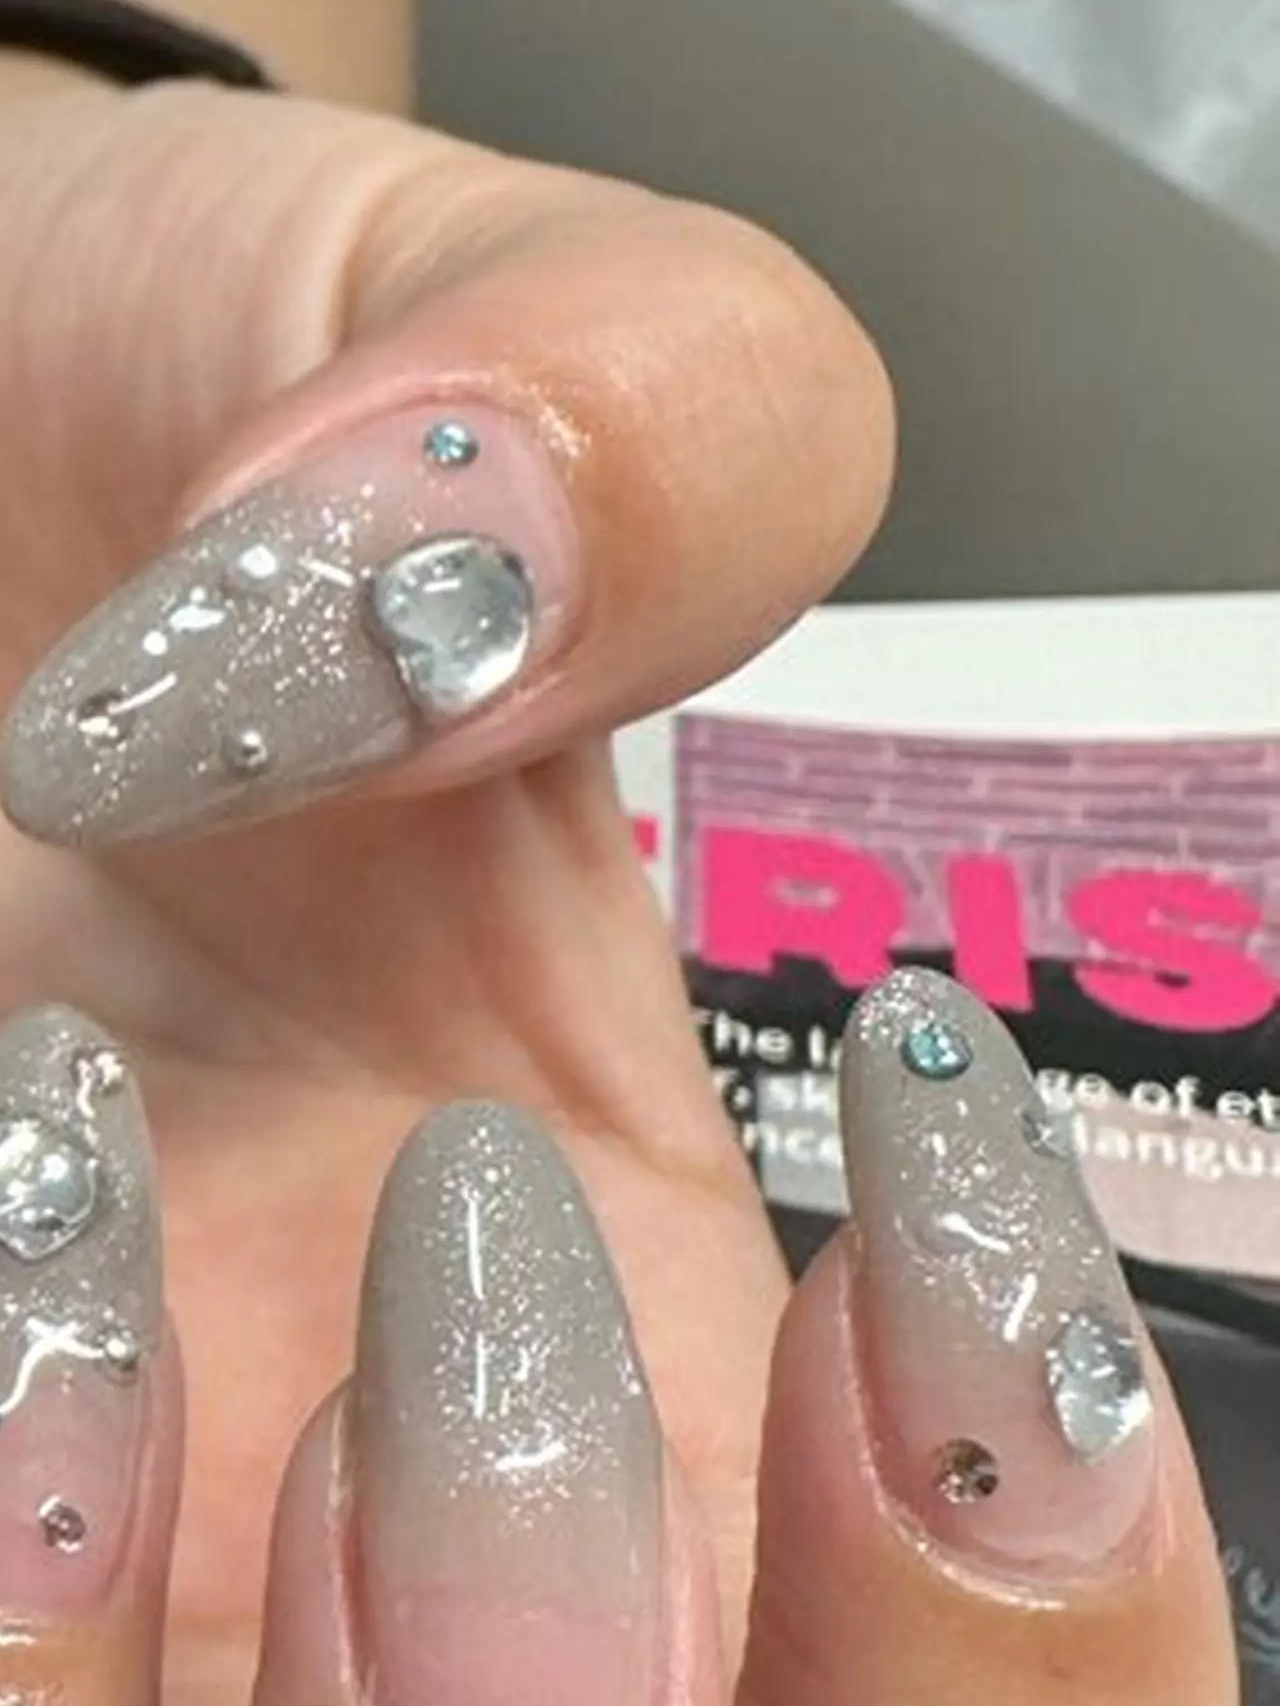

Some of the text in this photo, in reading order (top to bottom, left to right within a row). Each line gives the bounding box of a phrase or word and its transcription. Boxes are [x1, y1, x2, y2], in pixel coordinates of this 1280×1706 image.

[698, 821, 1280, 1035] RIS
[1131, 1073, 1202, 1119] of
[1070, 1111, 1280, 1185] langu
